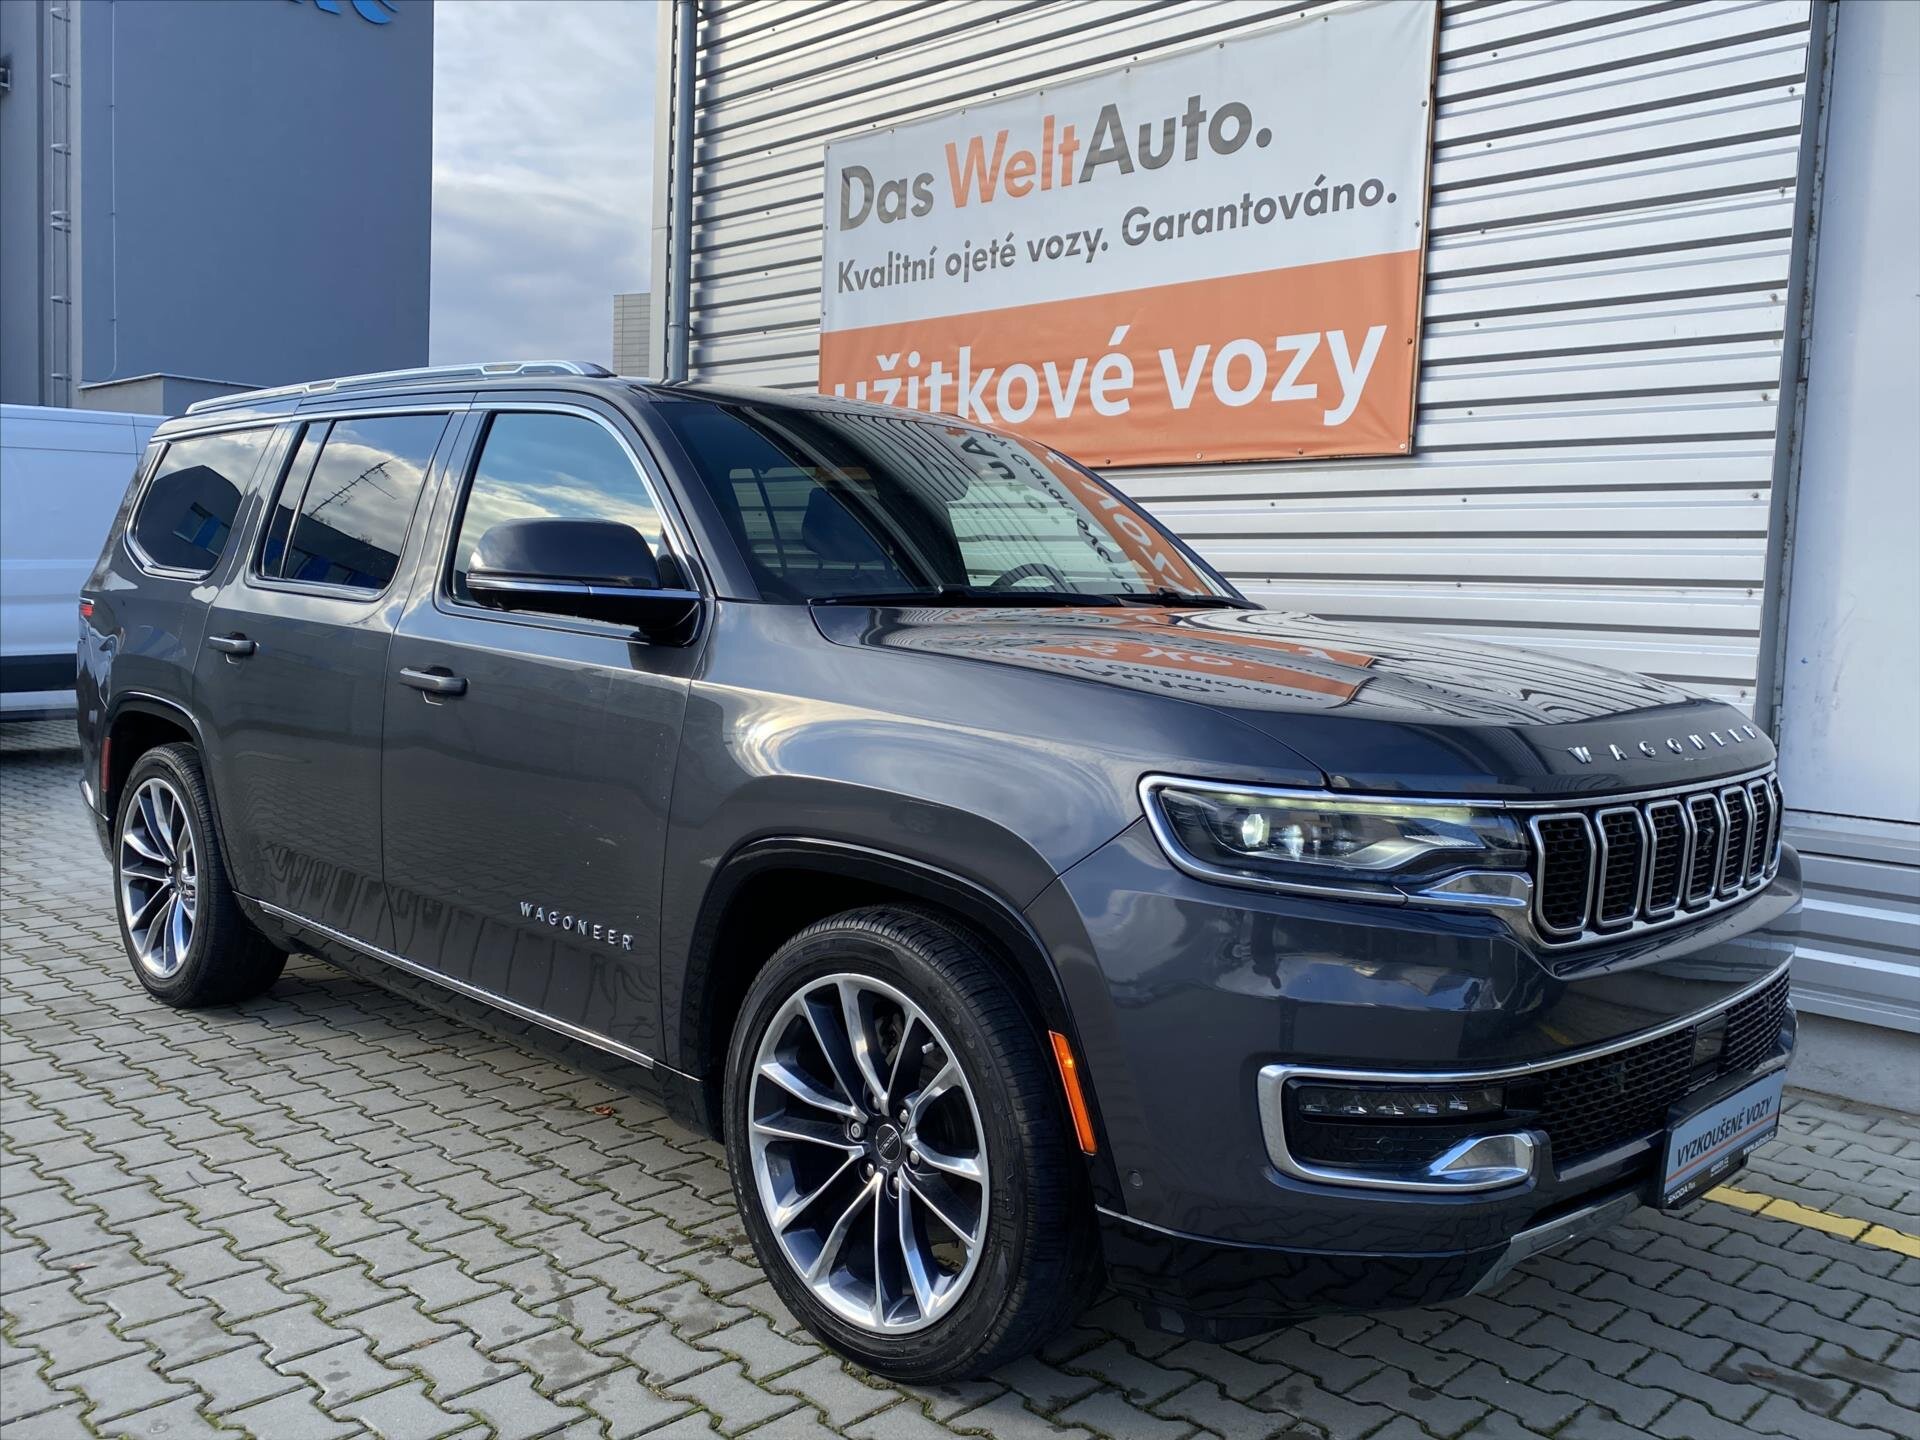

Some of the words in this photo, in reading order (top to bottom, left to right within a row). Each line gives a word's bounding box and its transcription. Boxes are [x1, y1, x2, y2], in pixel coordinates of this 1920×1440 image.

[840, 164, 934, 231] Das
[945, 95, 1273, 208] WeltAuto.
[838, 245, 937, 293] Kvalitní
[945, 231, 1016, 283] ojeté
[1027, 227, 1109, 264] vozy.
[1122, 174, 1397, 246] Garantováno.
[1158, 324, 1387, 426] vozy
[520, 901, 633, 951] WAGONEER
[1677, 1108, 1745, 1167] VYZKOUŠENÉ
[1746, 1096, 1773, 1125] VOZY
